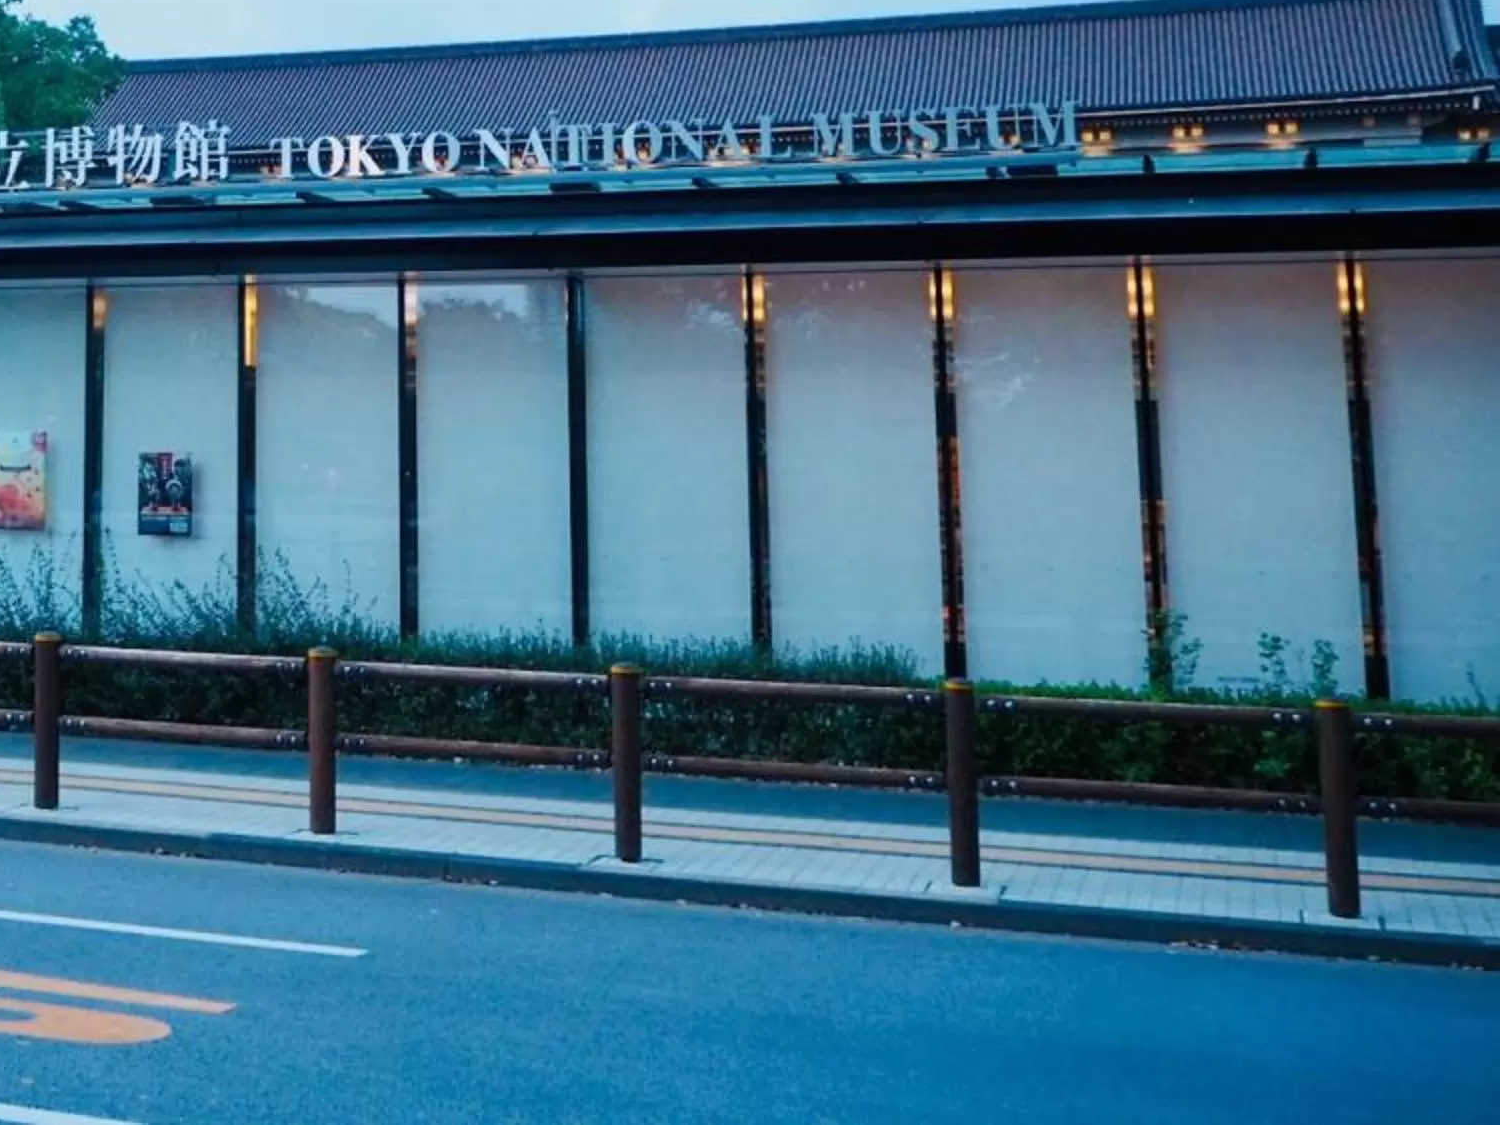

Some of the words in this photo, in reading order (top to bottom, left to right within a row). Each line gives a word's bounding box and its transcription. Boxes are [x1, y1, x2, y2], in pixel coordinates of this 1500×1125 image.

[271, 130, 460, 179] TOKYO
[475, 114, 793, 172] NATIONAL
[812, 101, 1080, 159] MUSEUM
